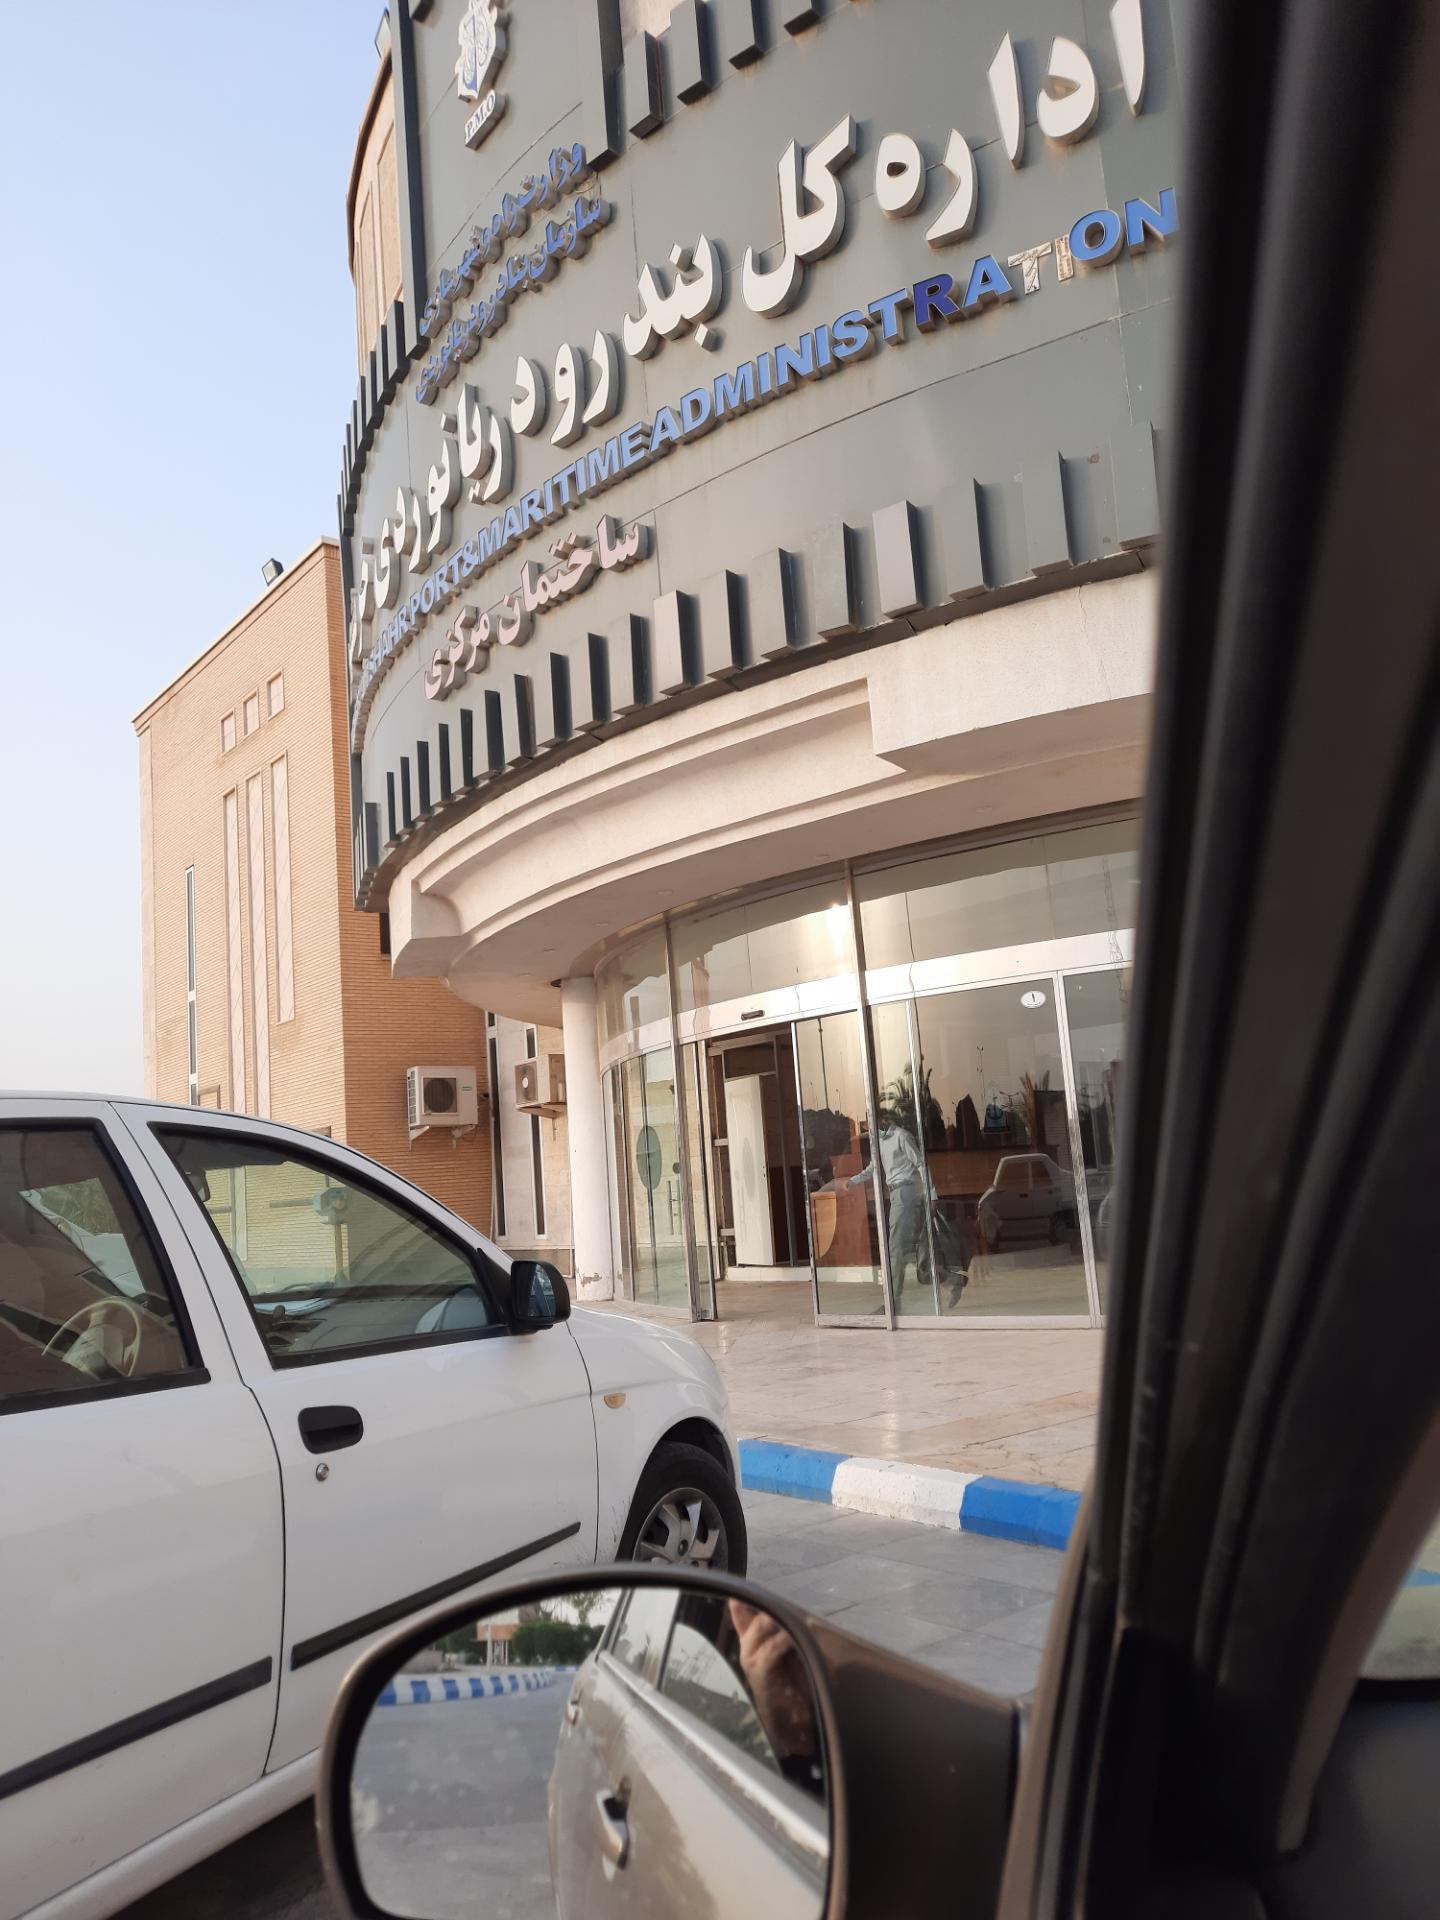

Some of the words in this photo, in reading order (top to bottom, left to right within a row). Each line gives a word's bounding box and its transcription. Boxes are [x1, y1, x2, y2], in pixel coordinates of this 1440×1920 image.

[529, 195, 603, 279] سازمان
[742, 114, 855, 314] کل
[498, 513, 648, 646] ساختمان
[424, 607, 490, 700] مرکزی
